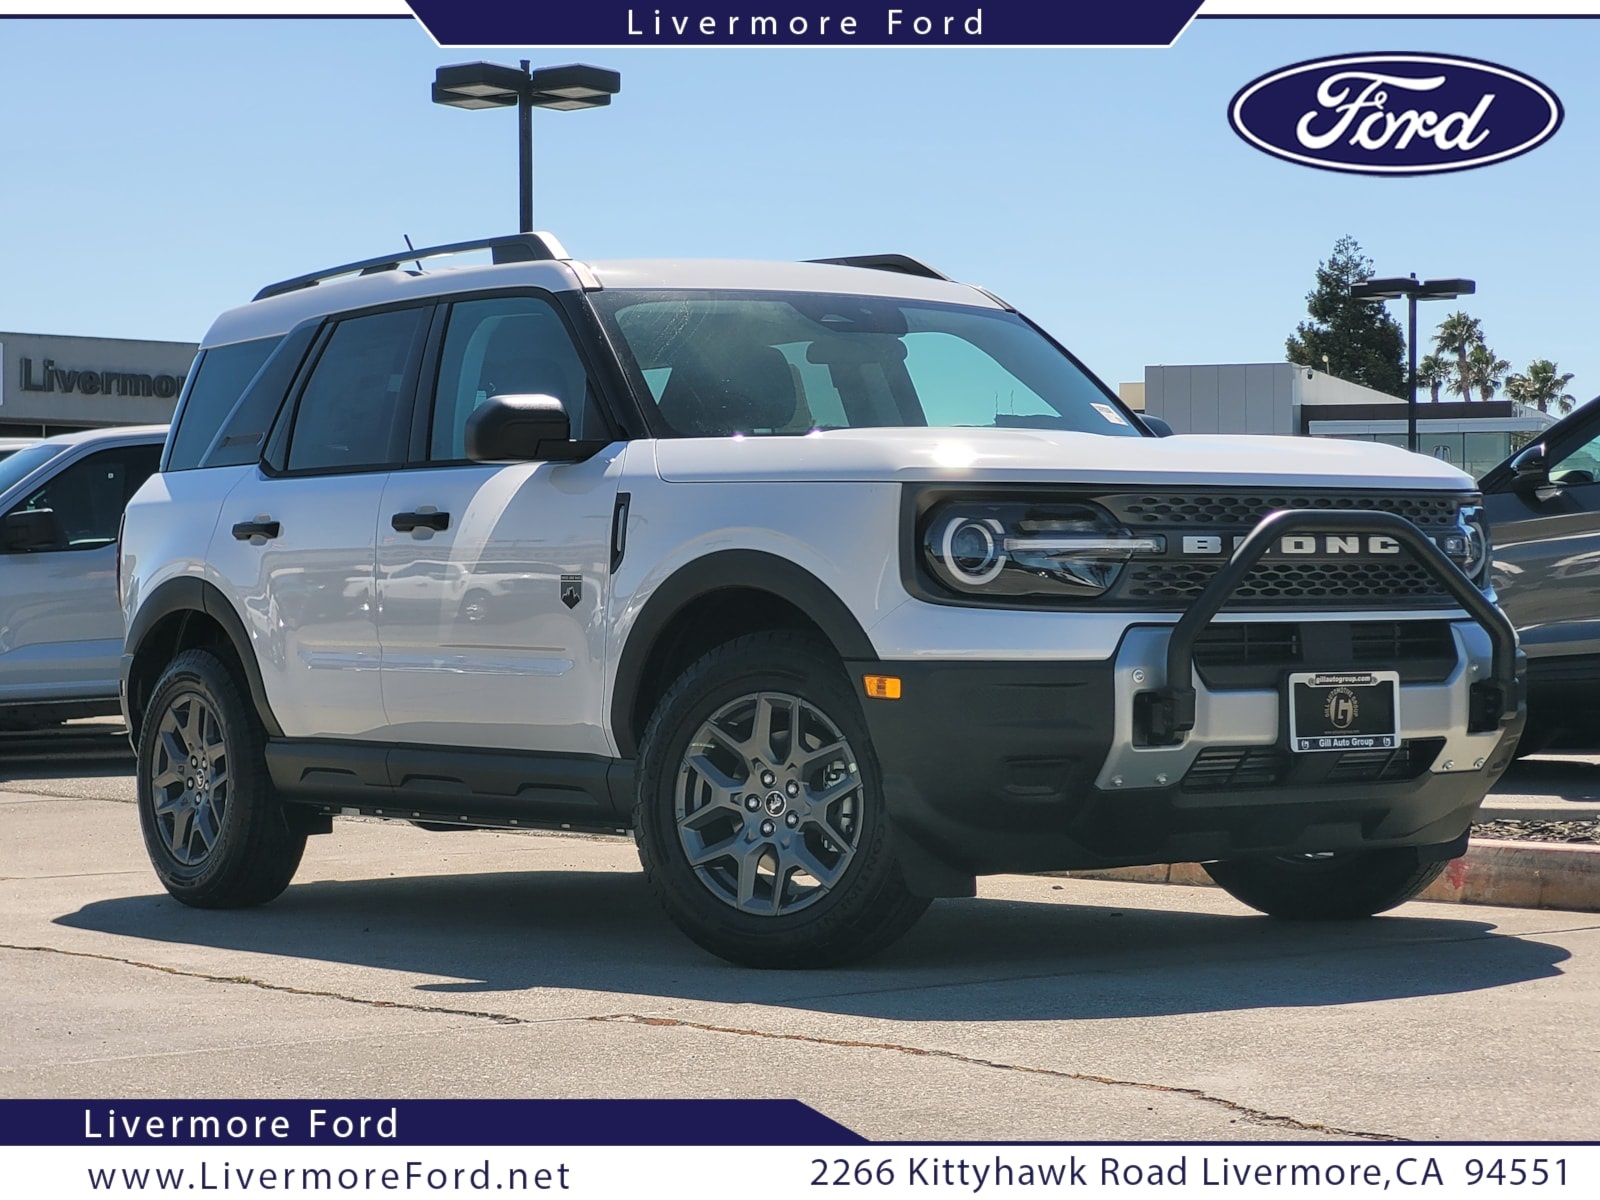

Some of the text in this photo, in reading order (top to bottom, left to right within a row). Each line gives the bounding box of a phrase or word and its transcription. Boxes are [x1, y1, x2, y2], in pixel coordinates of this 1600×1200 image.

[1183, 536, 1437, 554] BONC
[1316, 676, 1370, 684] gillautogroup.com
[1319, 737, 1374, 748] Gill Auto Group
